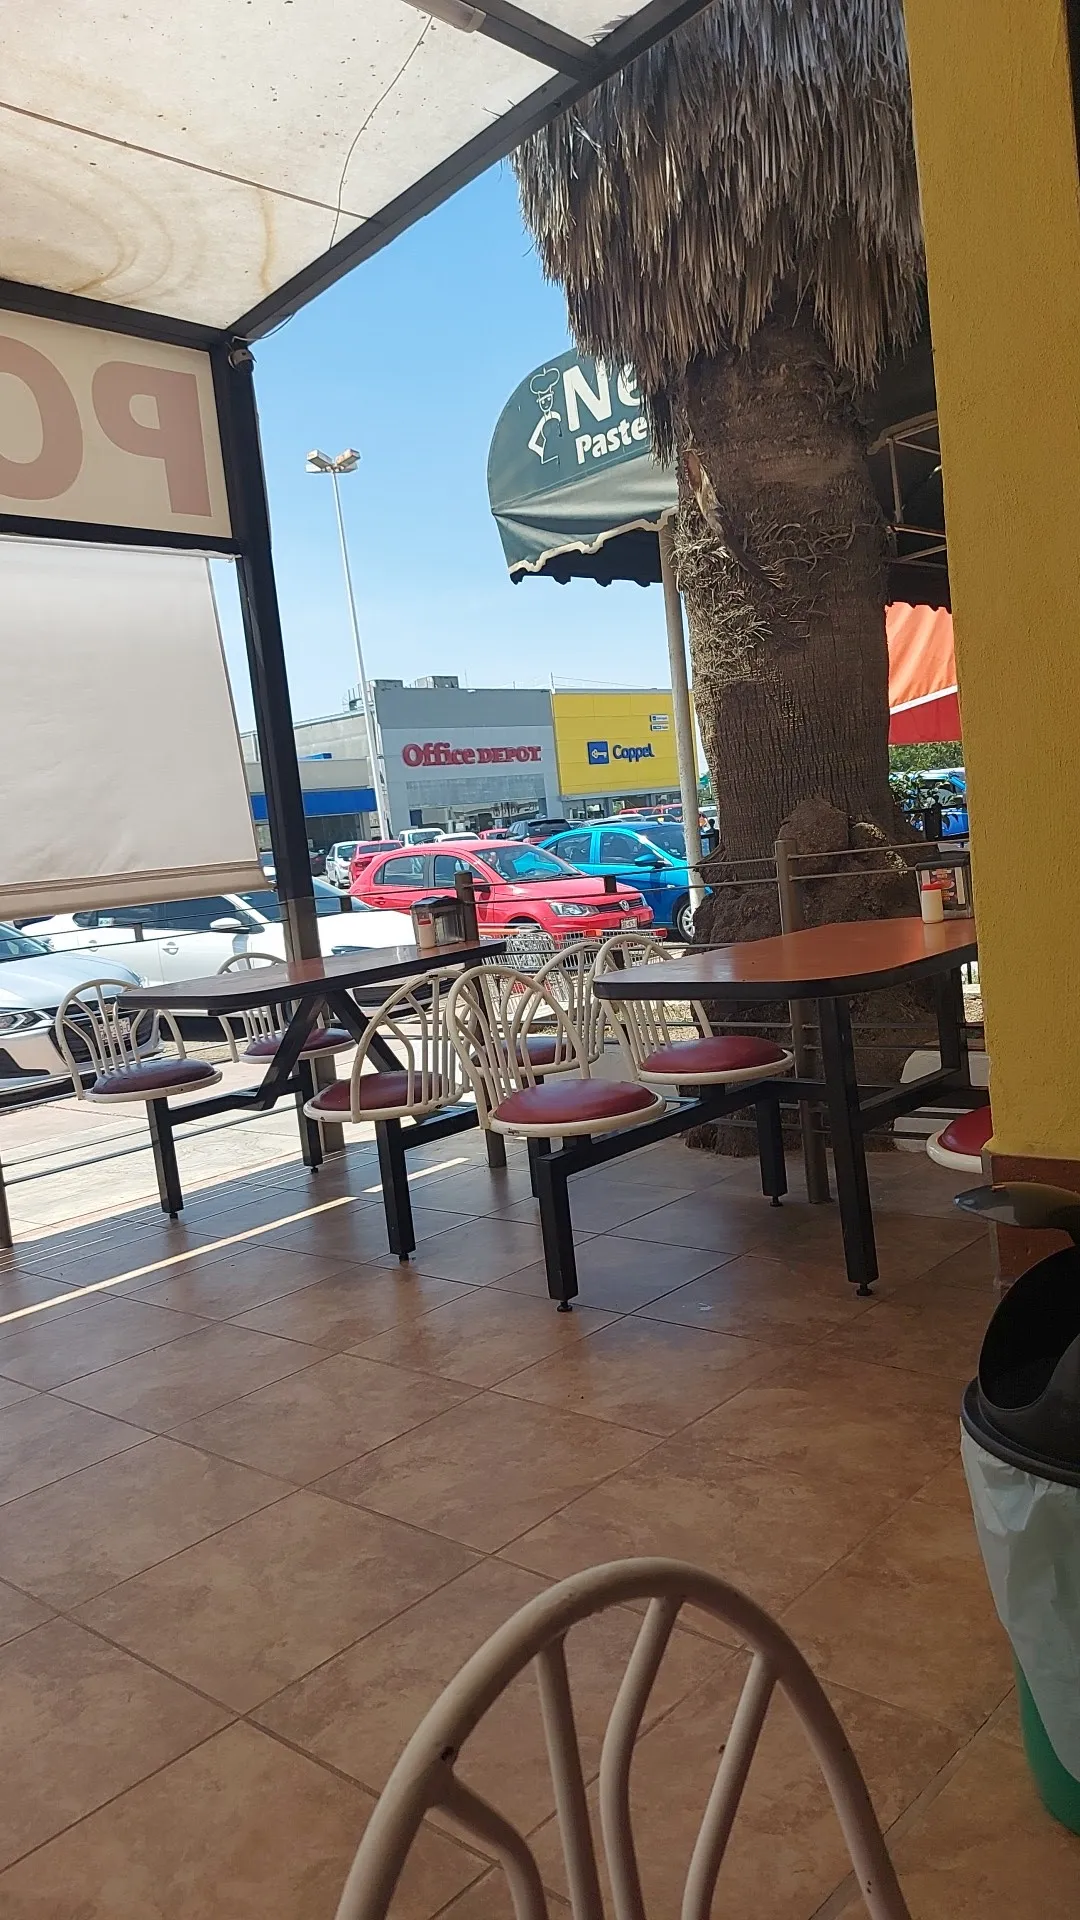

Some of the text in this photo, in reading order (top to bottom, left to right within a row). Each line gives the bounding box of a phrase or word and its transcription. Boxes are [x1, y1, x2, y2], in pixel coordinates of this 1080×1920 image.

[575, 415, 648, 465] Paste
[402, 742, 542, 767] Office DEPOT
[612, 743, 655, 763] Coppel
